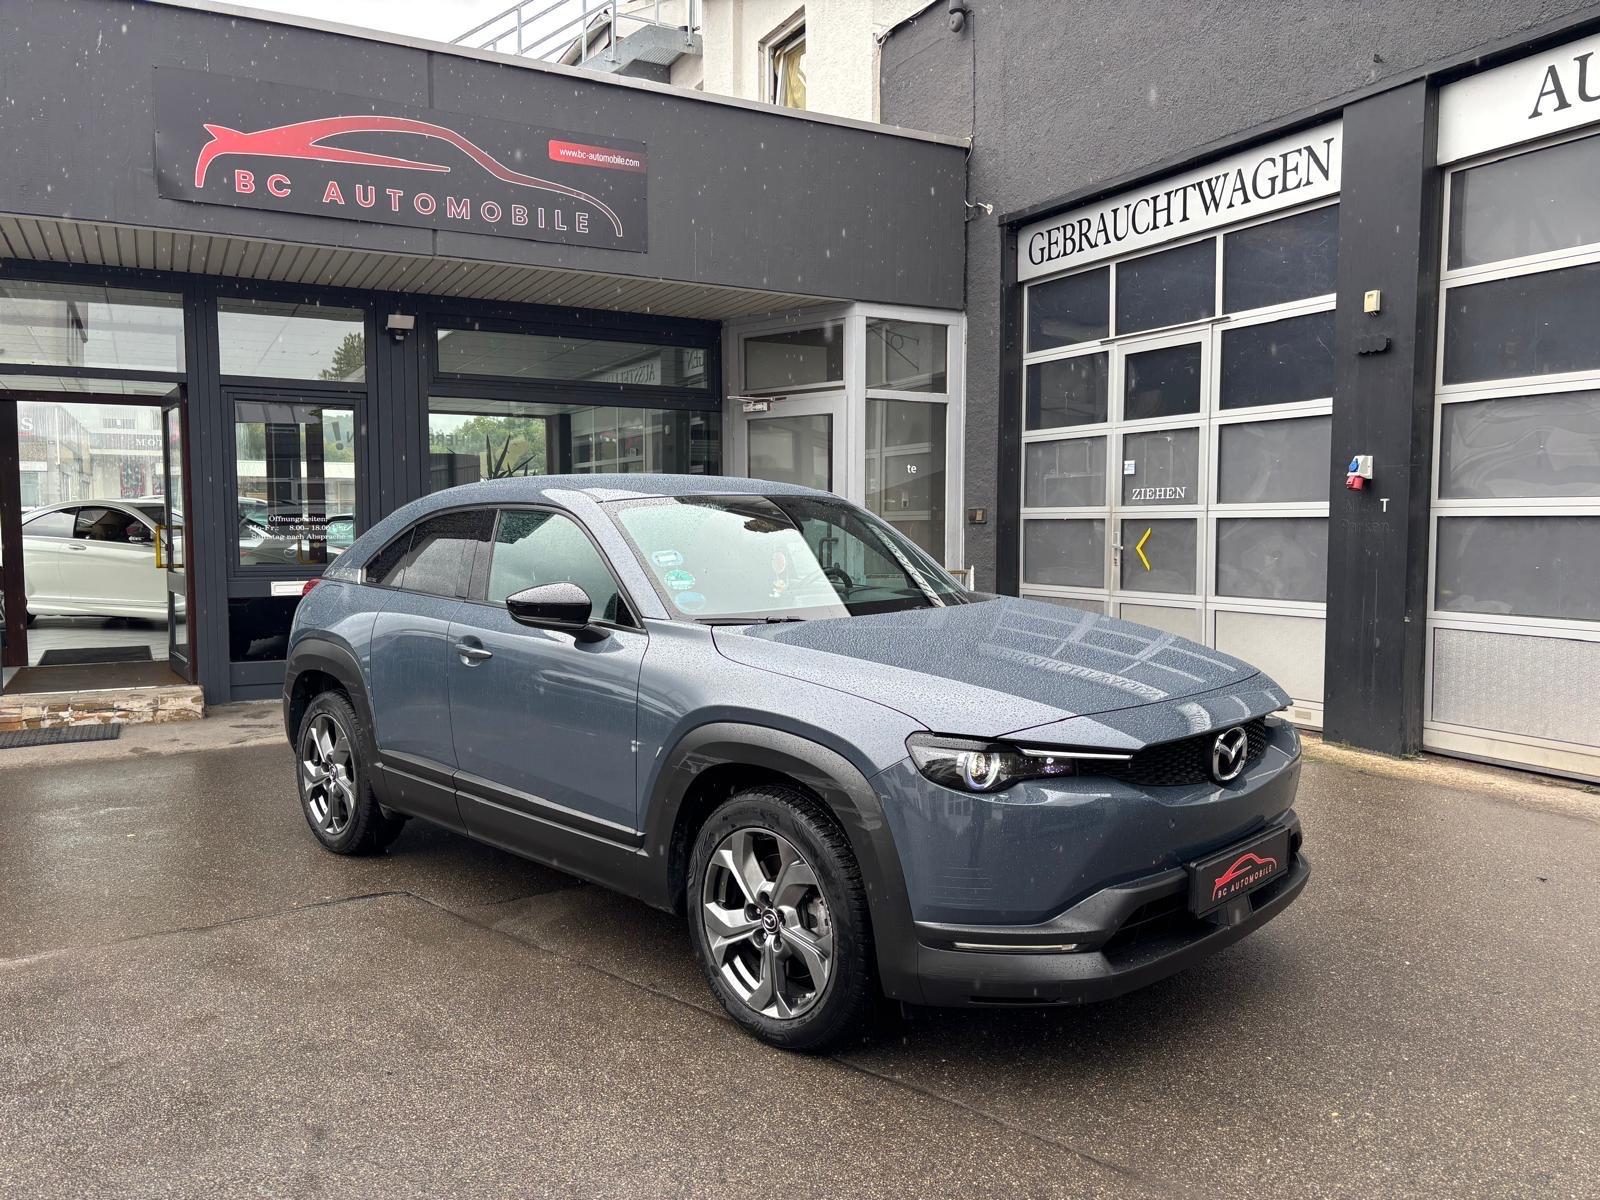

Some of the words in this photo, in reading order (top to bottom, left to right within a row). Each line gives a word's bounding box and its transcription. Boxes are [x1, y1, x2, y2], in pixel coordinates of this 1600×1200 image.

[559, 148, 640, 167] www.bc-automobile.com
[234, 169, 291, 198] BC
[322, 180, 589, 233] AUTOMOBILE
[1028, 137, 1335, 266] GEBRAUCHTWAGEN
[907, 464, 917, 473] te
[1132, 486, 1187, 500] ZIEHEN
[1380, 498, 1390, 512] T
[1217, 888, 1228, 899] BC
[1230, 864, 1272, 892] AUTOMOBILE
